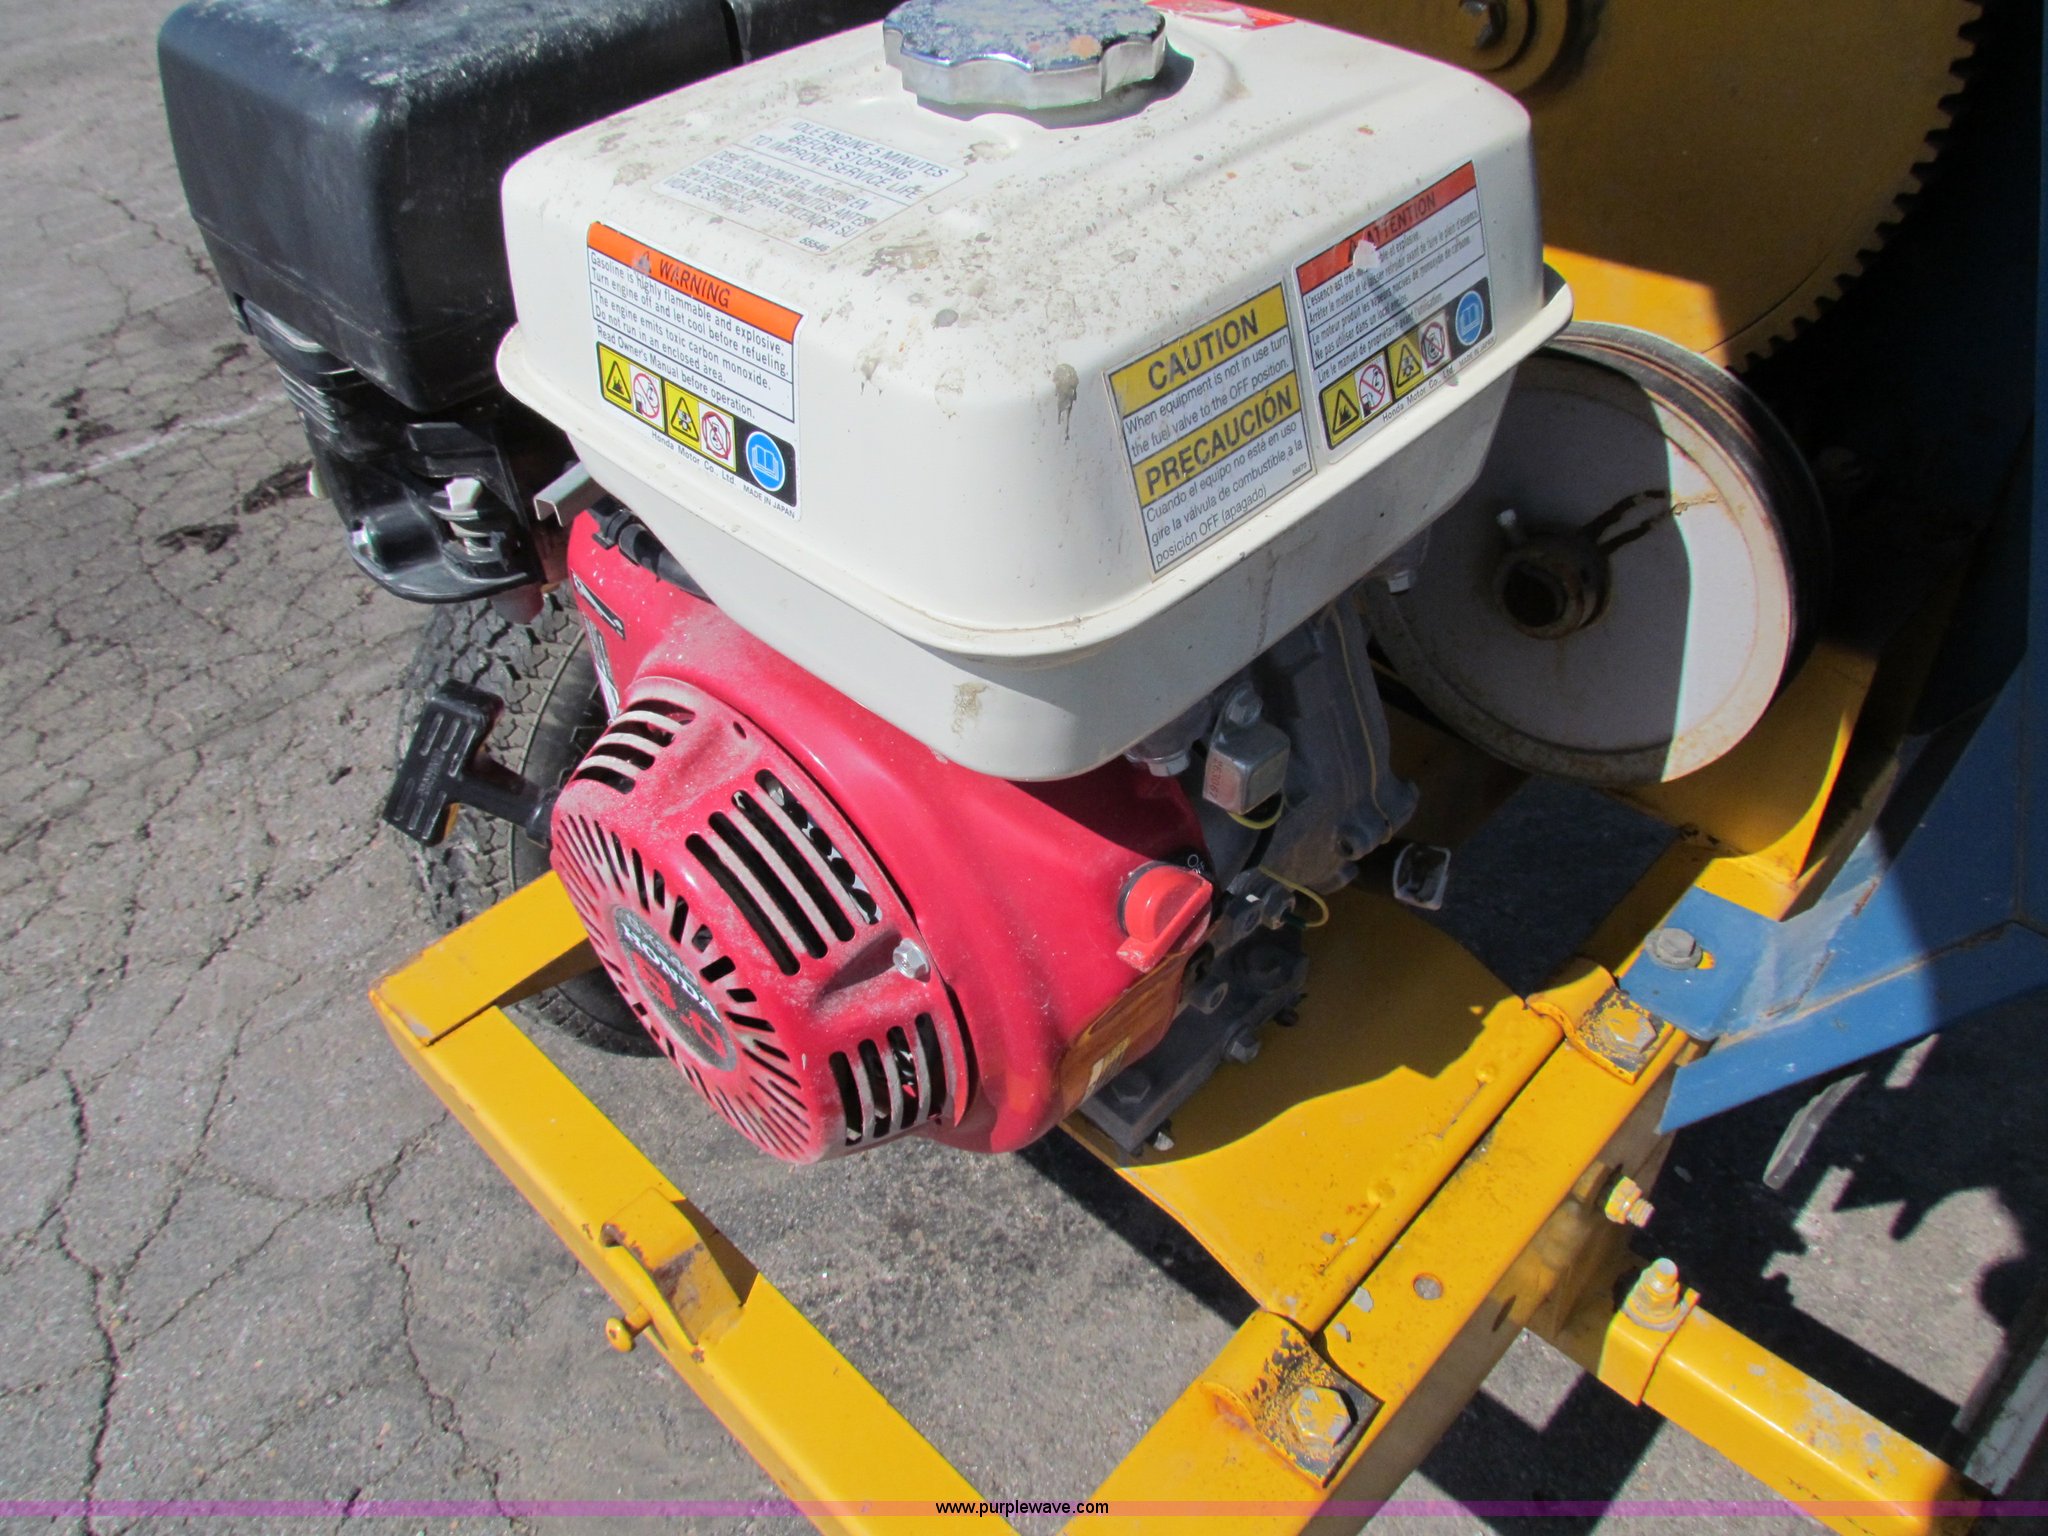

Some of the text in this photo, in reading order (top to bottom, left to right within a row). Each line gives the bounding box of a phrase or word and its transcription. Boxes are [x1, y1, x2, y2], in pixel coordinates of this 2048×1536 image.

[749, 135, 923, 198] TO IMPROVE SERVICE LIFE
[789, 134, 913, 179] BEFORE STOPPING
[790, 121, 949, 176] IDLE ENGINE 5 MINUTES
[779, 204, 841, 229] EXTENDER
[836, 225, 858, 236] SU
[810, 184, 855, 203] MOTOR
[850, 199, 870, 209] EN
[832, 208, 874, 226] ANTES
[1365, 191, 1435, 248] ATTENTION
[590, 251, 783, 359] Gasoline is highly flammable and explosive.
[659, 258, 730, 309] WARNING
[1305, 281, 1333, 309] L'essence
[1328, 298, 1335, 312] le
[1335, 287, 1354, 307] moteur
[1354, 282, 1361, 295] et
[591, 267, 788, 378] Turn engine off and let cool before refueling.
[593, 289, 771, 390] The engine emits toxic carbon monoxide.
[595, 304, 725, 383] Do not run in an enclosed area.
[1147, 308, 1258, 392] CAUTION
[1311, 330, 1320, 346] Le
[1320, 319, 1340, 340] moteur
[1341, 305, 1361, 329] produit
[1314, 346, 1323, 361] Ne
[1324, 341, 1335, 358] pas
[1334, 326, 1354, 348] utiliser
[1354, 316, 1368, 334] dans
[1369, 313, 1376, 325] un
[596, 324, 755, 421] Read Owner's Manual before operation.
[1125, 332, 1288, 435] When equipment is not in use turn
[1317, 365, 1329, 383] Lire
[1329, 360, 1337, 375] le
[1336, 346, 1359, 370] manuel
[1358, 340, 1366, 355] de
[1131, 355, 1289, 458] the fuel valve to the OFF position.
[1382, 401, 1404, 423] Honda
[1406, 384, 1426, 405] Motor
[1442, 363, 1455, 378] Ltd.
[651, 430, 674, 450] Honda
[678, 445, 699, 465] Motor
[721, 470, 736, 486] Ltd.
[1143, 380, 1292, 495] PRECAUCIÓN
[743, 484, 795, 519] MADE IN JAPAN
[1145, 420, 1297, 523] Cuando el equipo no esté en uso
[1150, 522, 1172, 547] gire
[1171, 514, 1182, 531] la
[1182, 492, 1217, 523] válvula
[1217, 483, 1231, 501] de
[1231, 447, 1286, 492] combustible
[1287, 446, 1293, 456] a
[1293, 436, 1302, 451] la
[1154, 482, 1267, 568] posición OFF (apagado)
[621, 922, 721, 1023] HONDA
[631, 951, 727, 1059] 8.0
